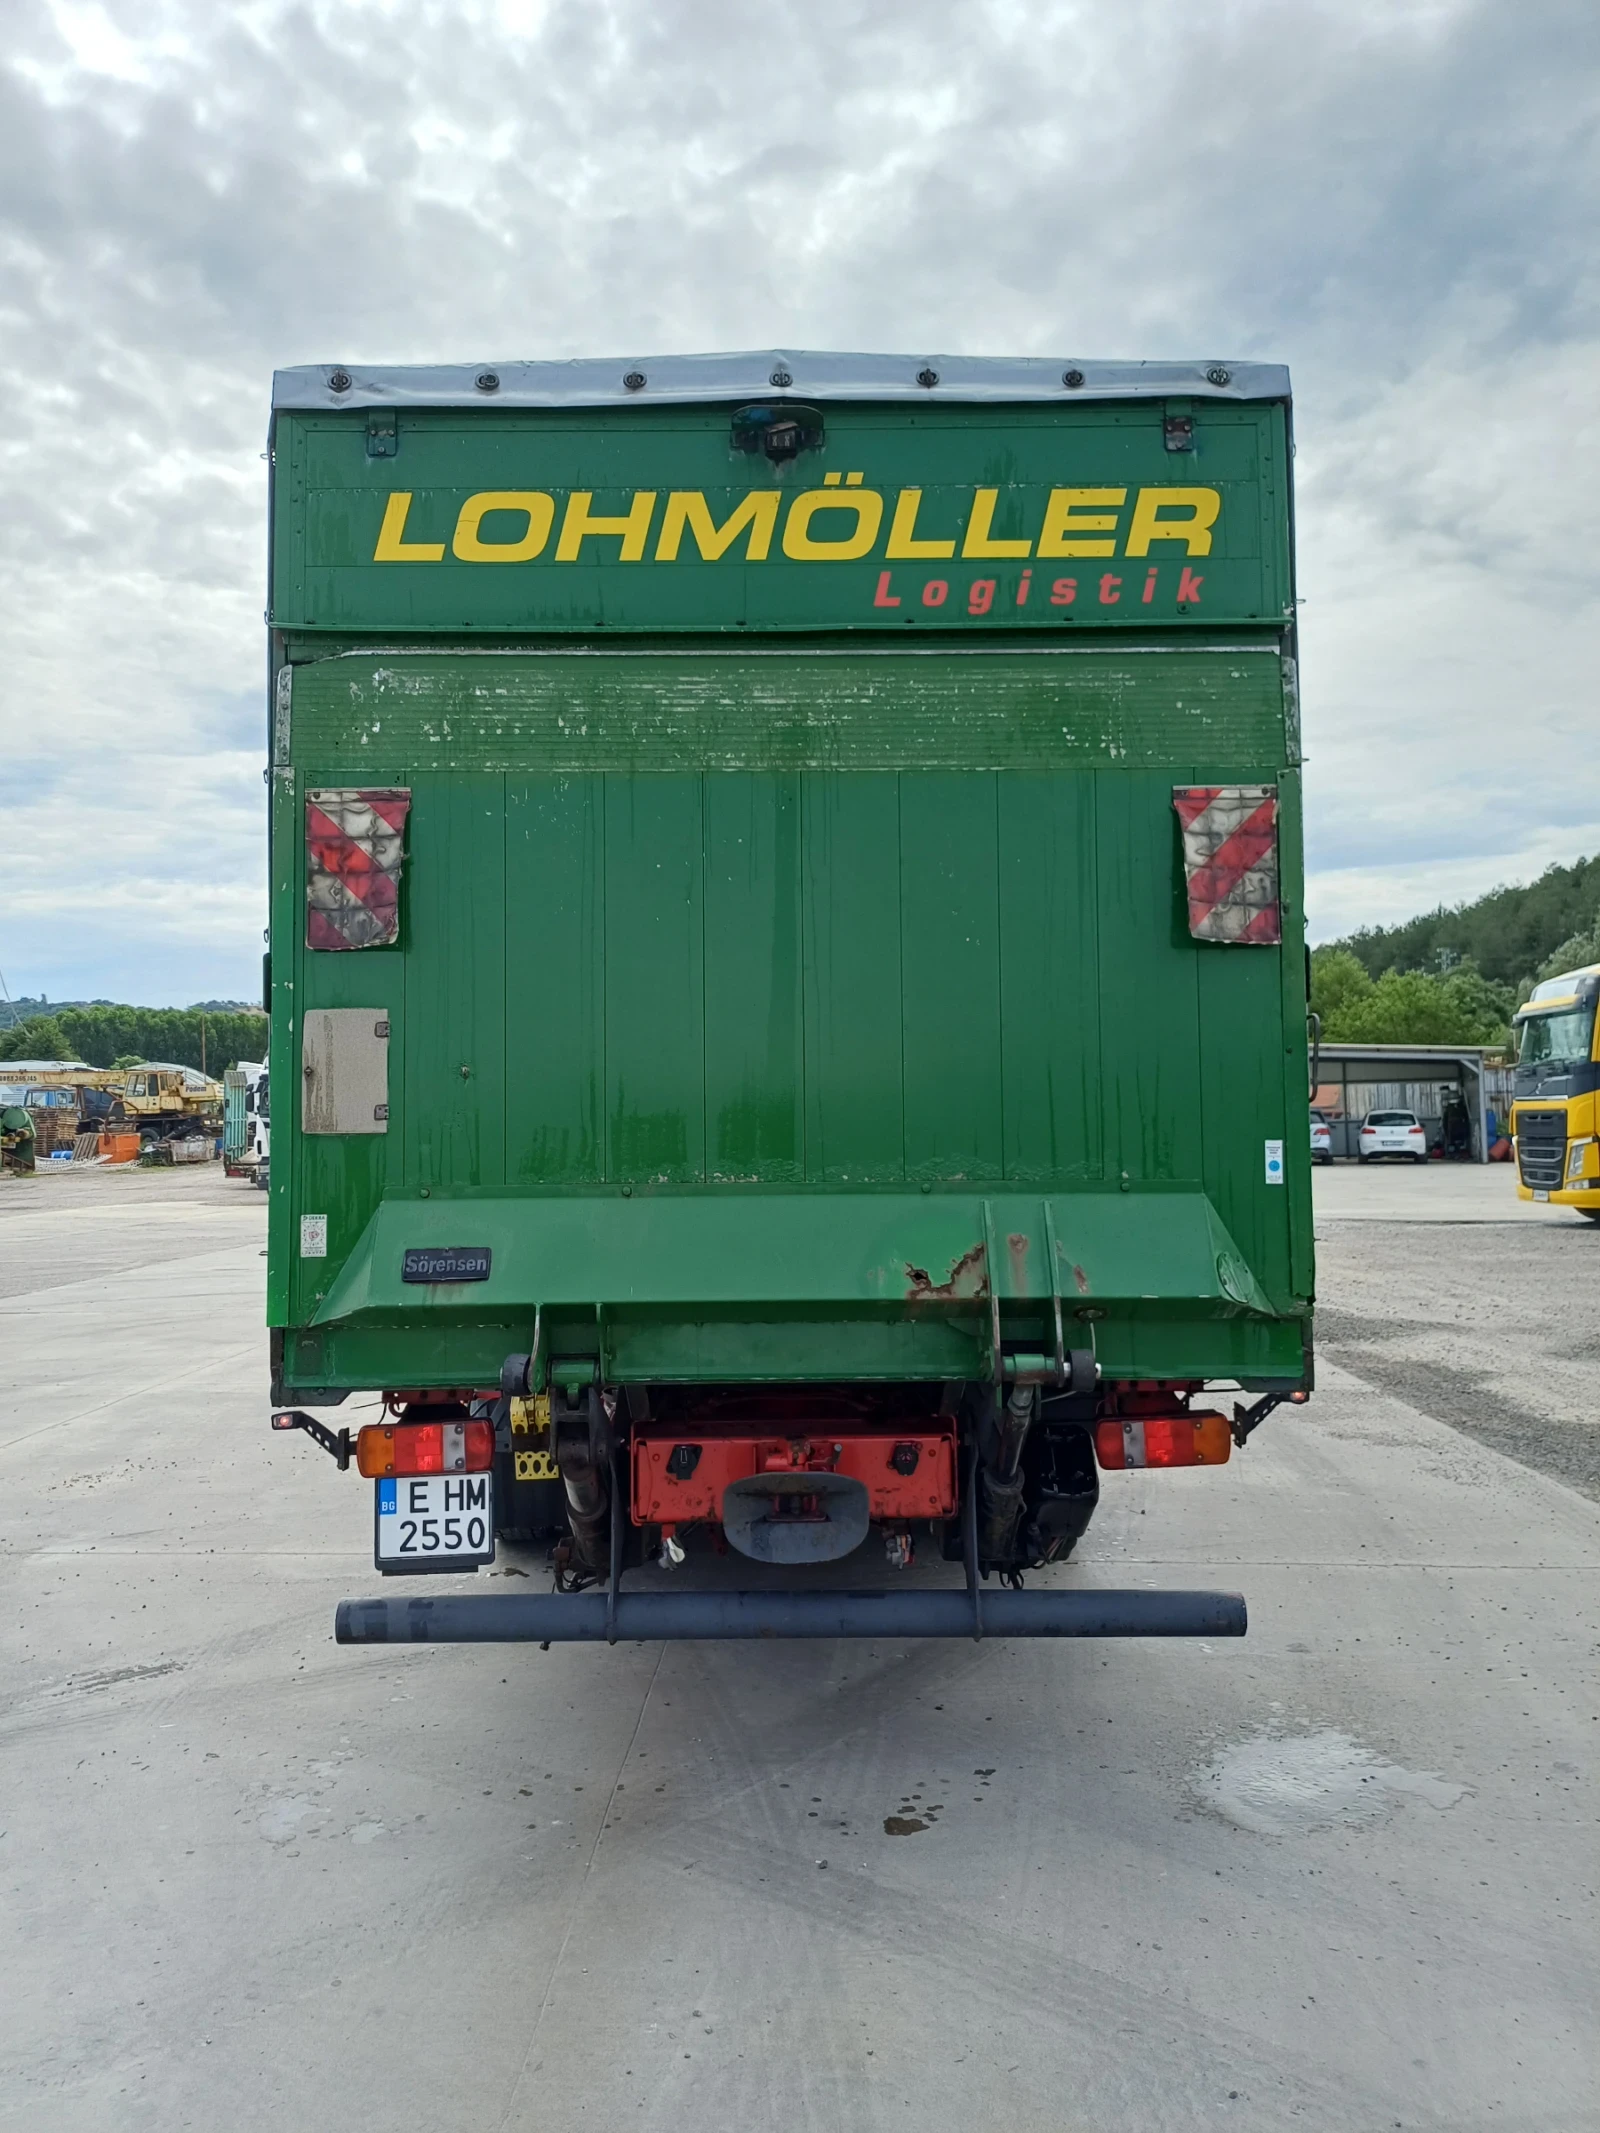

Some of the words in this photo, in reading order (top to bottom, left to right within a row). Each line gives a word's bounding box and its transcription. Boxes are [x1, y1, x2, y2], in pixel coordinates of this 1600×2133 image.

[373, 472, 1221, 563] LOHMÖLLER
[874, 568, 1205, 616] Logistik
[185, 1085, 207, 1093] Podem
[405, 1255, 488, 1274] Sörensen
[381, 1501, 396, 1512] BG
[410, 1481, 429, 1514] E
[444, 1478, 486, 1512] HM
[399, 1517, 486, 1553] 2550
